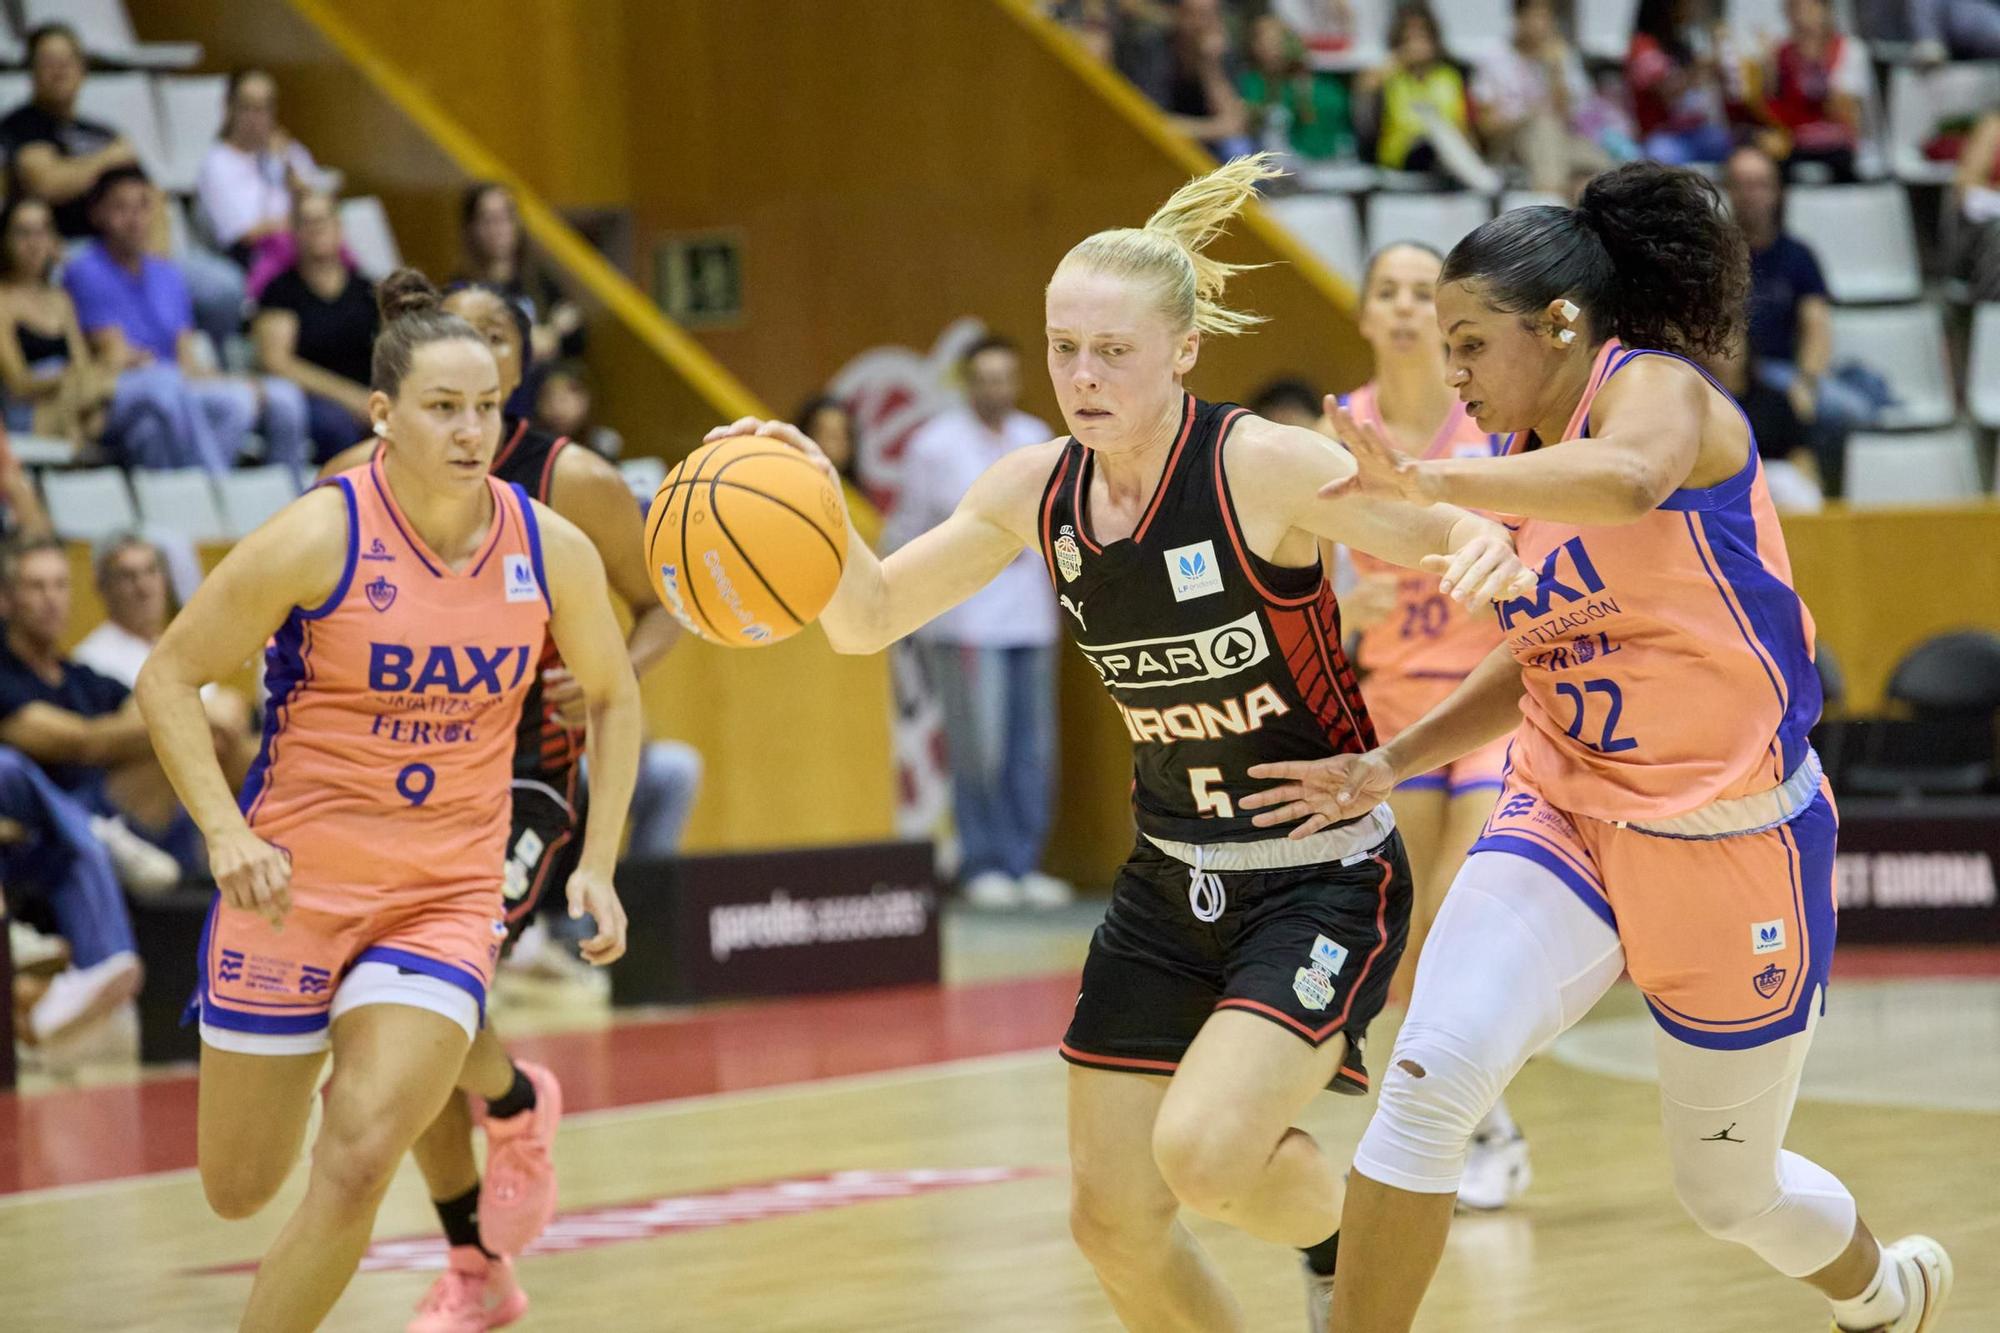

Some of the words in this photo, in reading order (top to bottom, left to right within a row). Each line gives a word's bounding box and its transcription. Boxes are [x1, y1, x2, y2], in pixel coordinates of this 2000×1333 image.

[1491, 536, 1606, 632] AXI
[369, 642, 531, 695] BAXI
[1110, 683, 1290, 744] IRONA
[1556, 678, 1639, 753] 22
[396, 762, 436, 807] 9
[1187, 767, 1235, 819] 5
